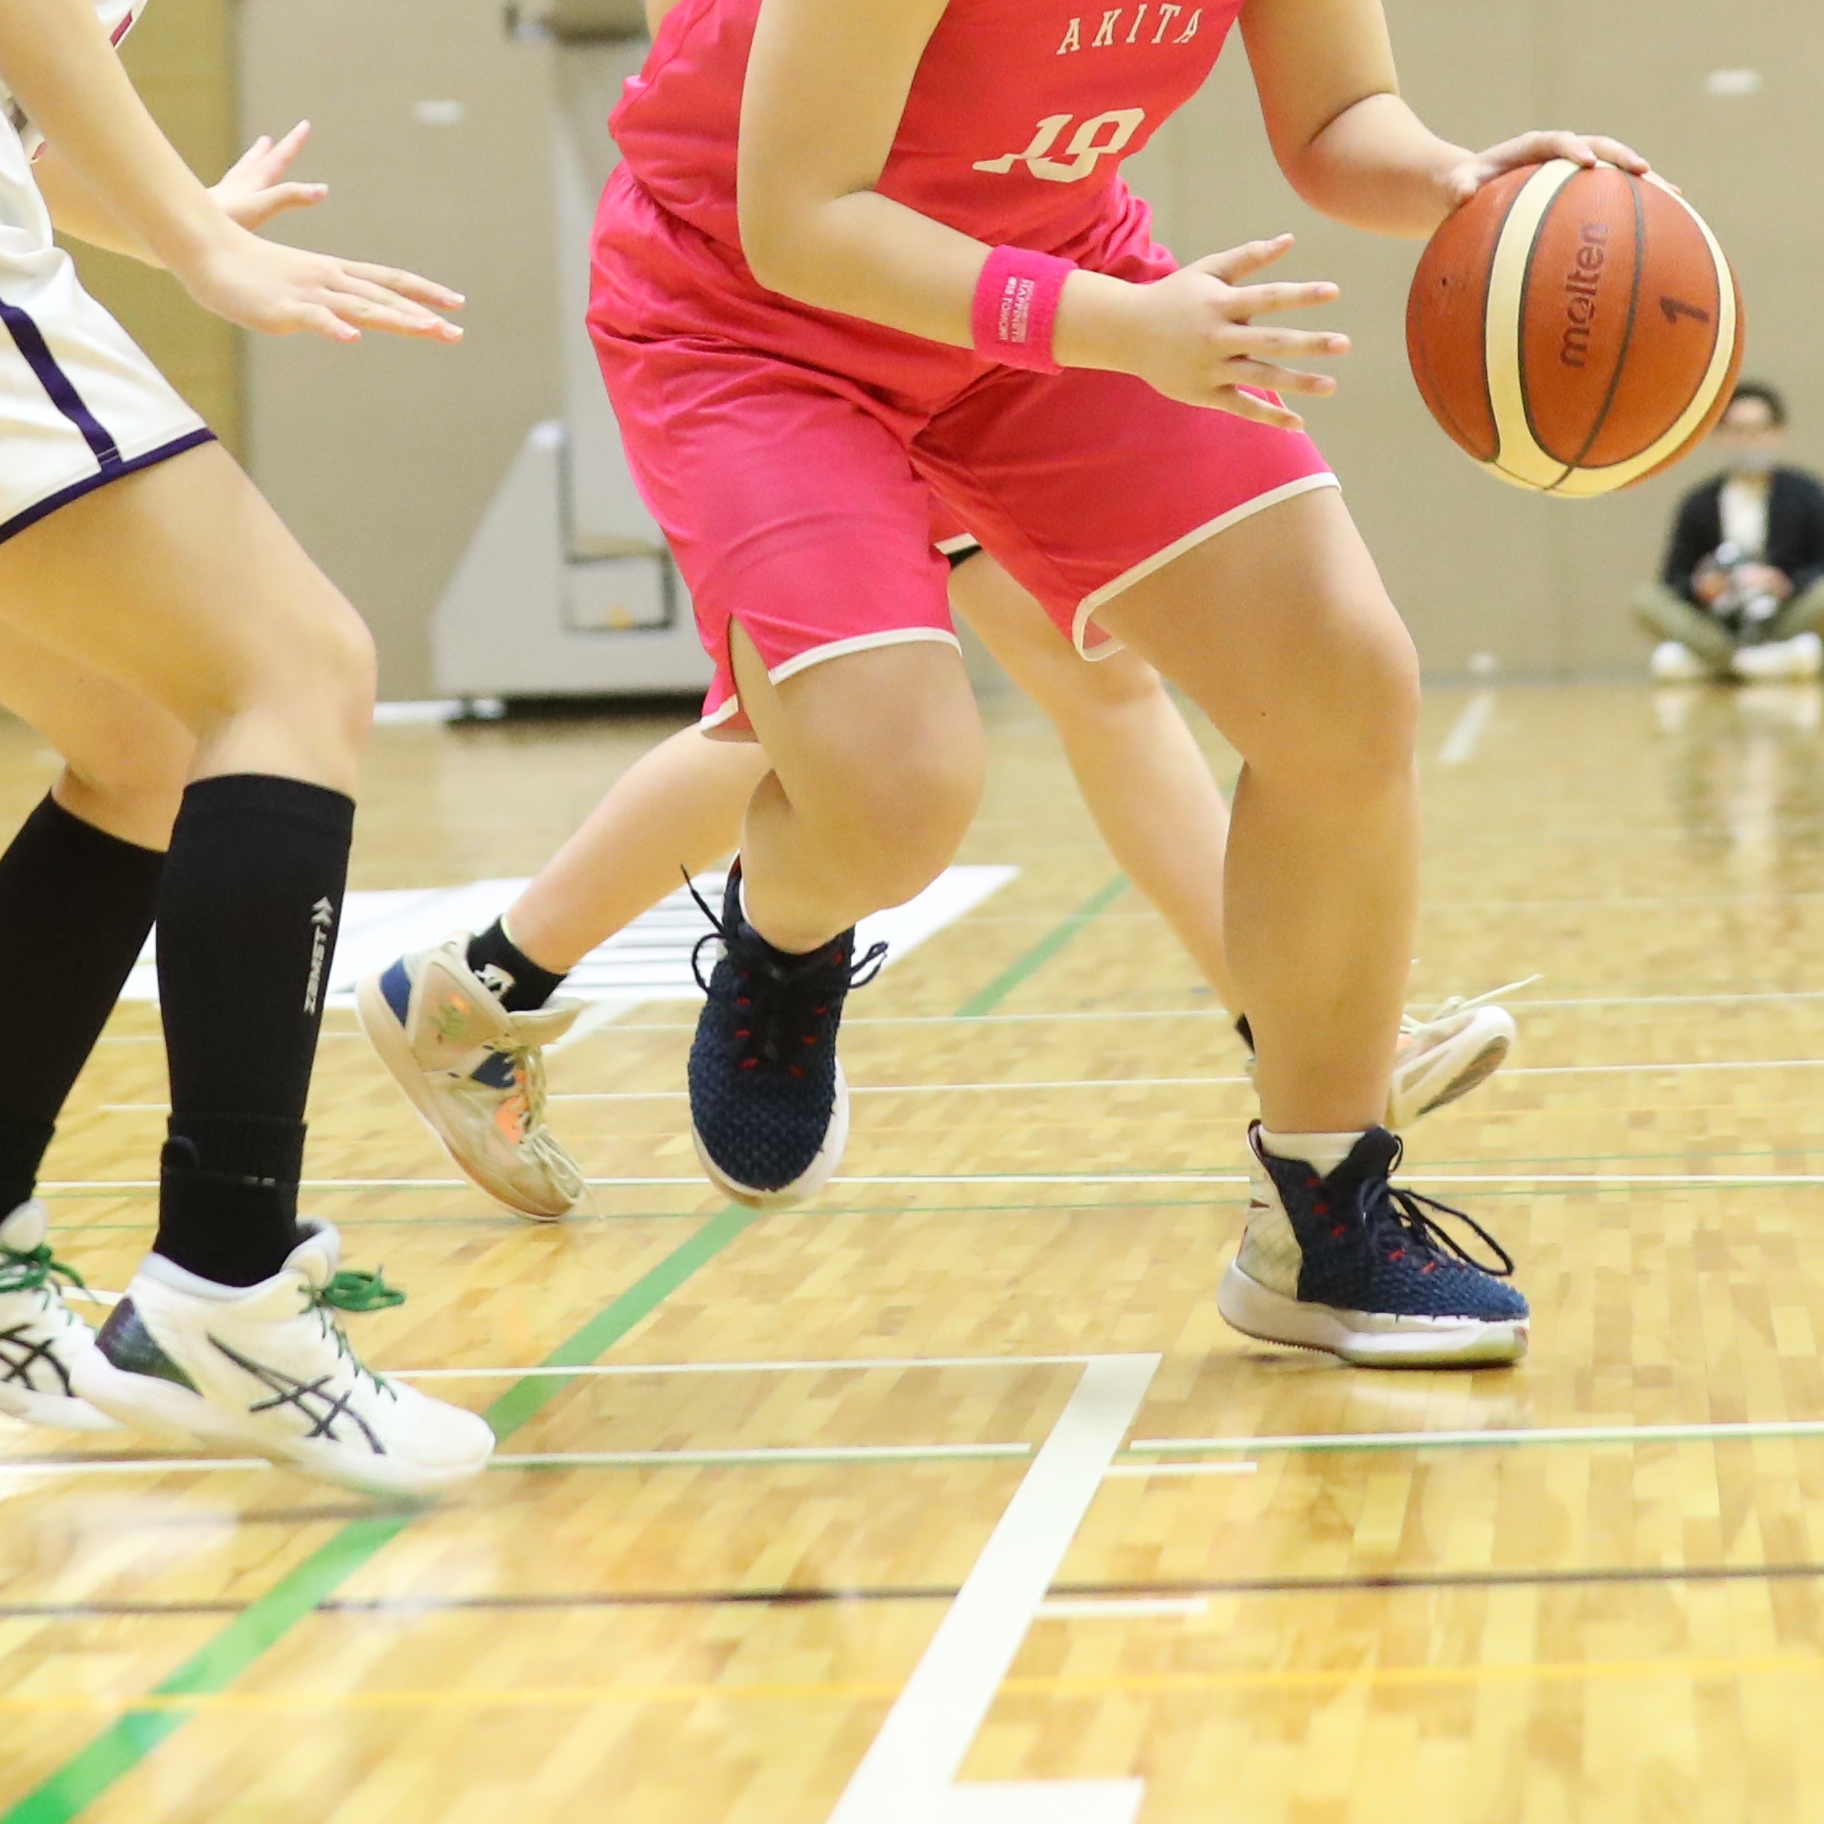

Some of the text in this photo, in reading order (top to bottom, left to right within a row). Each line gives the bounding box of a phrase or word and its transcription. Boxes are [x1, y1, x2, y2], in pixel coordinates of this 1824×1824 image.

[1056, 2, 1203, 55] AKITA
[1559, 223, 1609, 368] molten
[1659, 295, 1710, 324] 1
